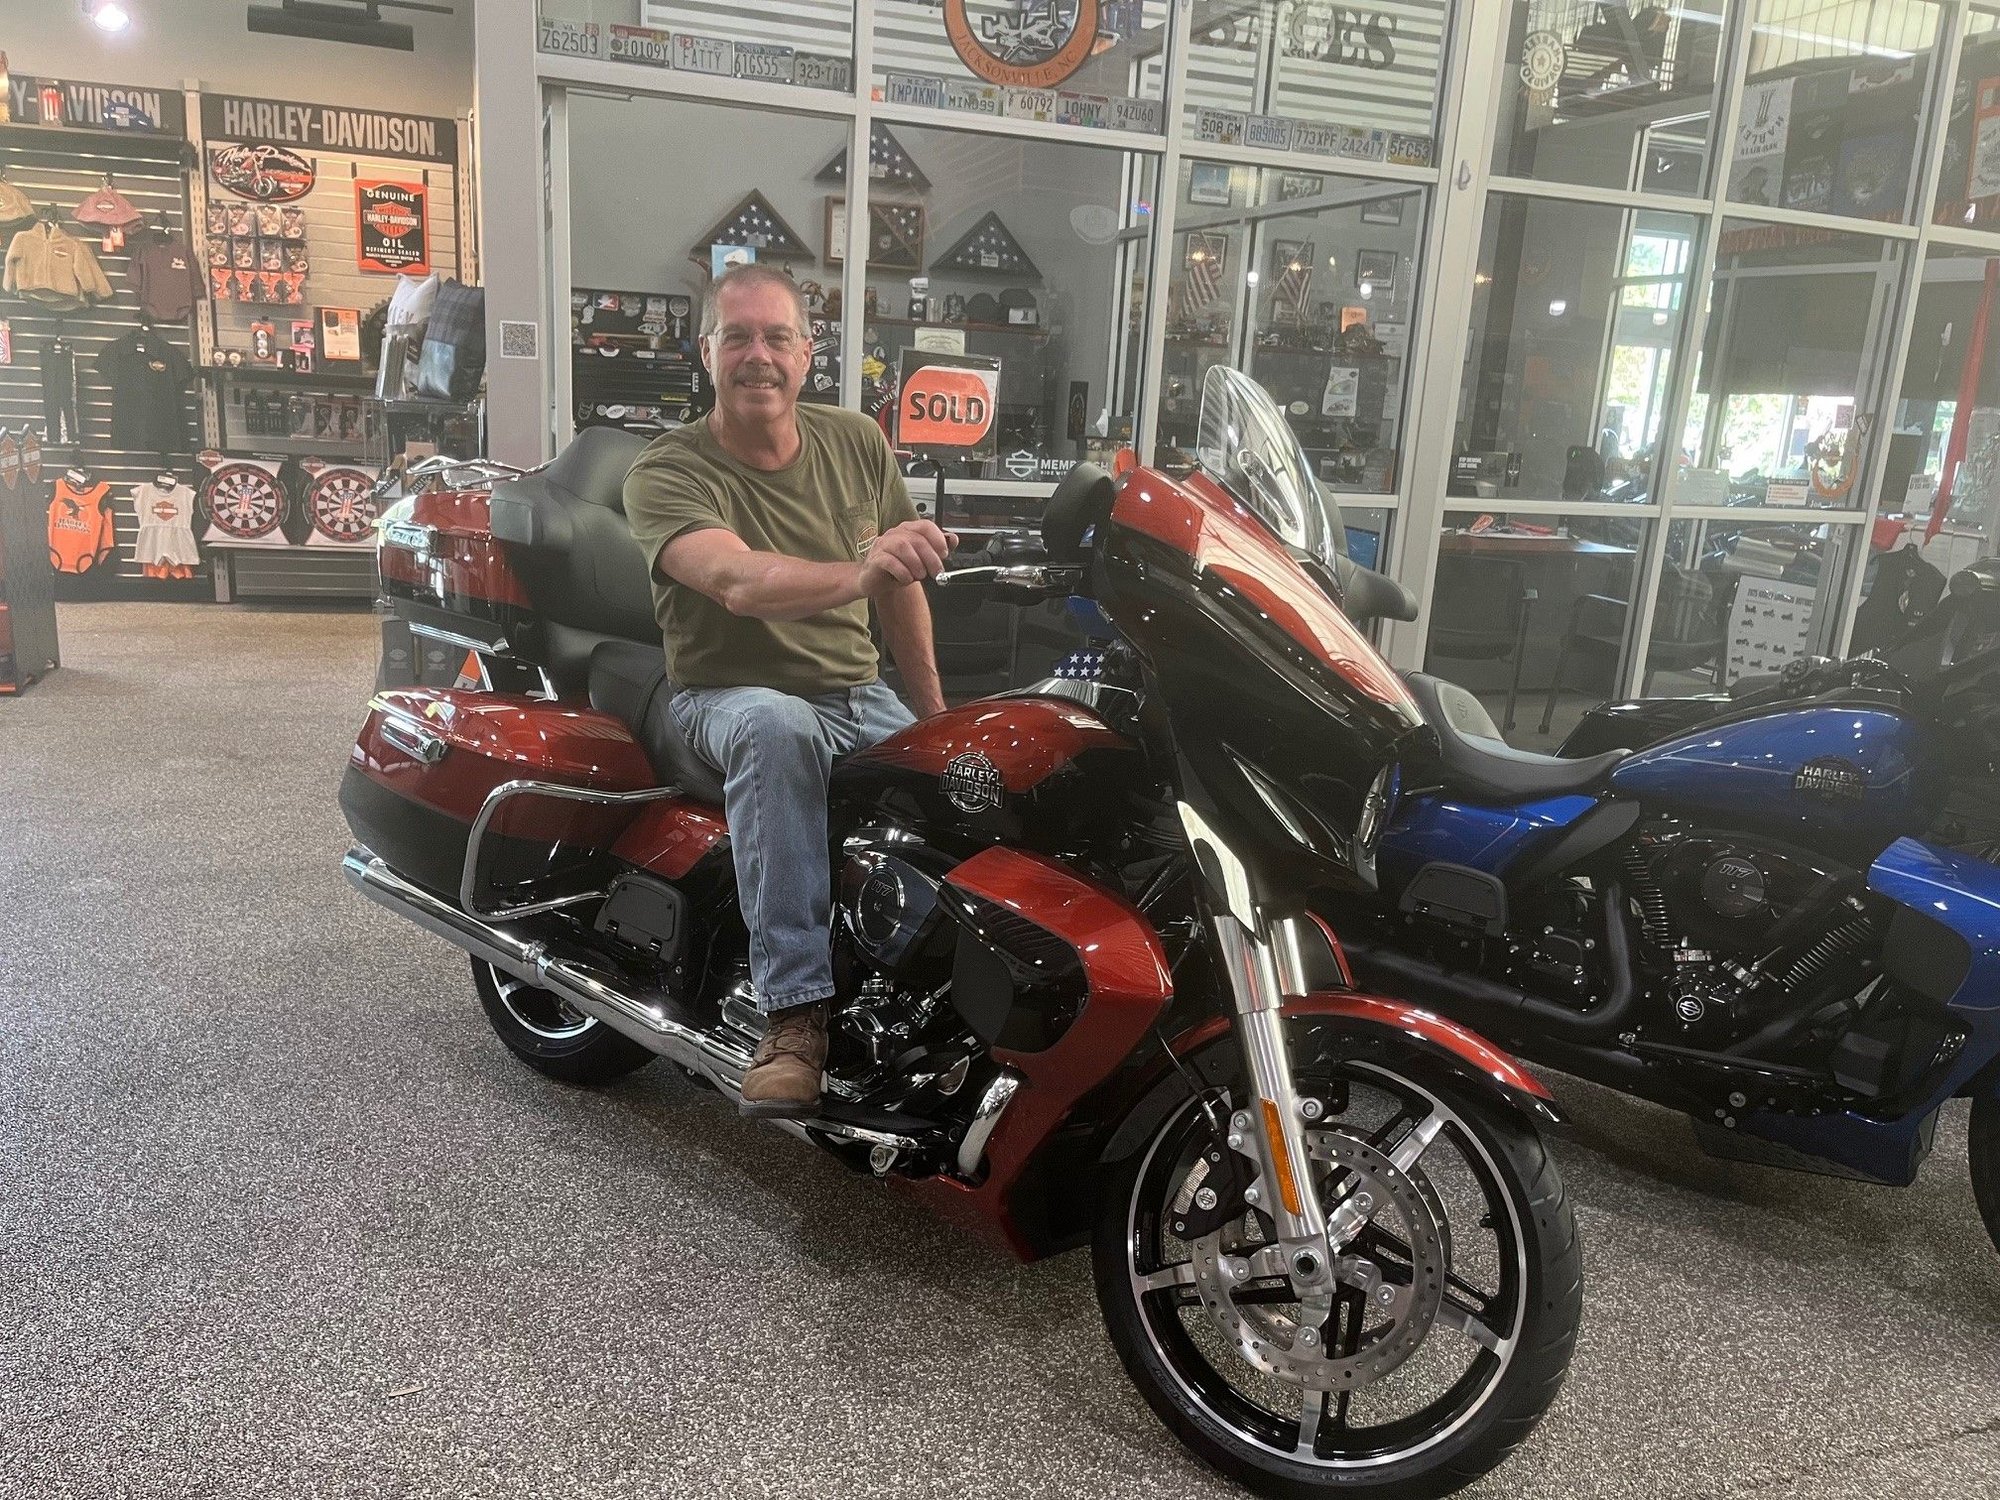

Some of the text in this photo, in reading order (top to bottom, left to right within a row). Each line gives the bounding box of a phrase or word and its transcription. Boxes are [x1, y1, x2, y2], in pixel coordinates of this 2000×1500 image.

[683, 46, 722, 71] FATTY
[734, 53, 778, 76] 61GS55
[1020, 95, 1053, 113] 60792
[223, 99, 436, 157] HARLEY-DAVIDSON
[1201, 119, 1224, 134] 508
[366, 188, 415, 203] GENUINE
[367, 213, 418, 226] HARLEY-DAVIDSON
[382, 237, 404, 249] OIL
[909, 391, 985, 426] SOLD
[942, 775, 1000, 804] DAVIDSON
[1719, 864, 1754, 878] 117
